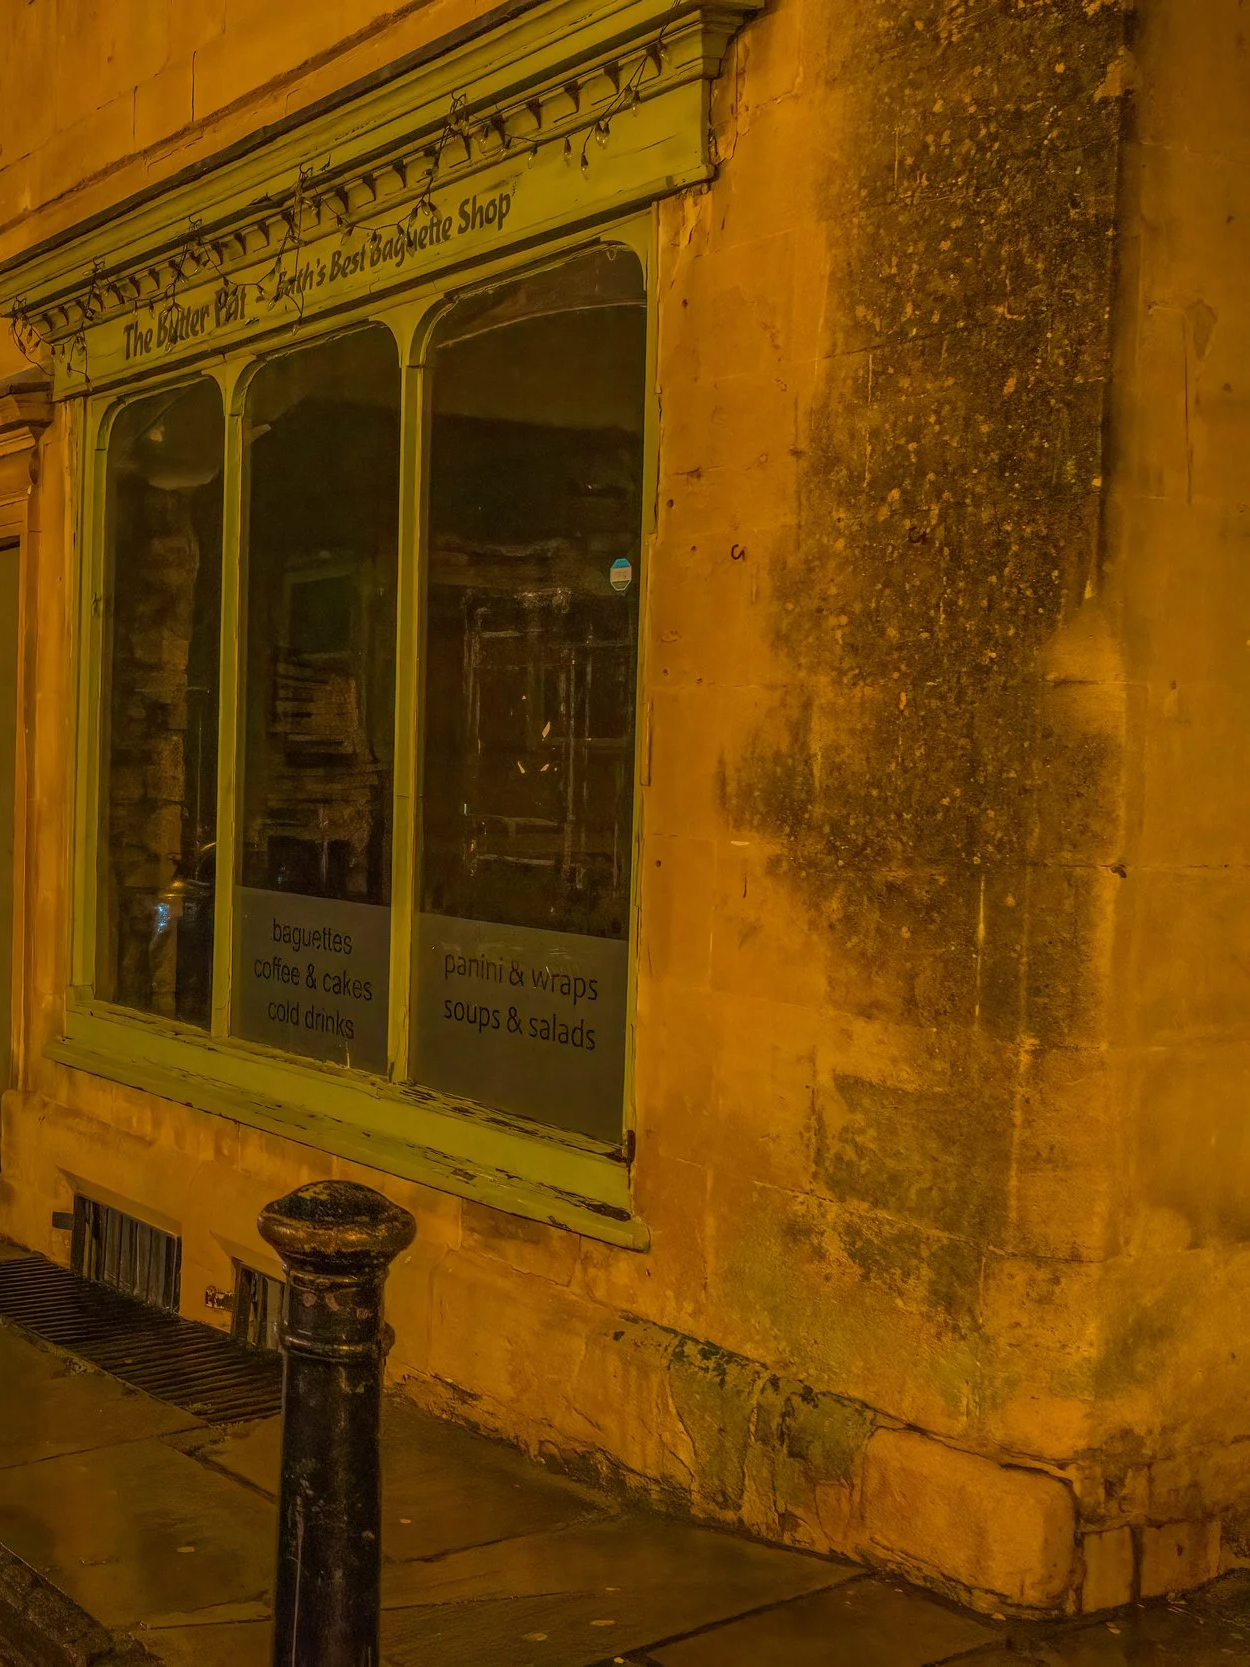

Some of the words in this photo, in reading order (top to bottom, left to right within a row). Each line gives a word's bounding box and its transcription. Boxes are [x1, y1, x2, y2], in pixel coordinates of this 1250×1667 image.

[123, 320, 153, 360] The
[157, 304, 210, 348] Butter
[214, 286, 246, 328] Pat
[329, 244, 366, 282] Best
[369, 215, 452, 267] Baguette
[457, 193, 511, 234] Shop
[272, 918, 352, 955] baguettes
[253, 957, 300, 987] coffee
[304, 964, 318, 990] &
[322, 970, 373, 1001] cakes
[444, 951, 503, 983] panini
[509, 960, 525, 987] &
[531, 968, 599, 1006] wraps
[268, 998, 300, 1027] cold
[304, 1004, 355, 1040] drinks
[443, 997, 501, 1034] soups
[507, 1006, 523, 1035] &
[529, 1013, 596, 1052] salads
